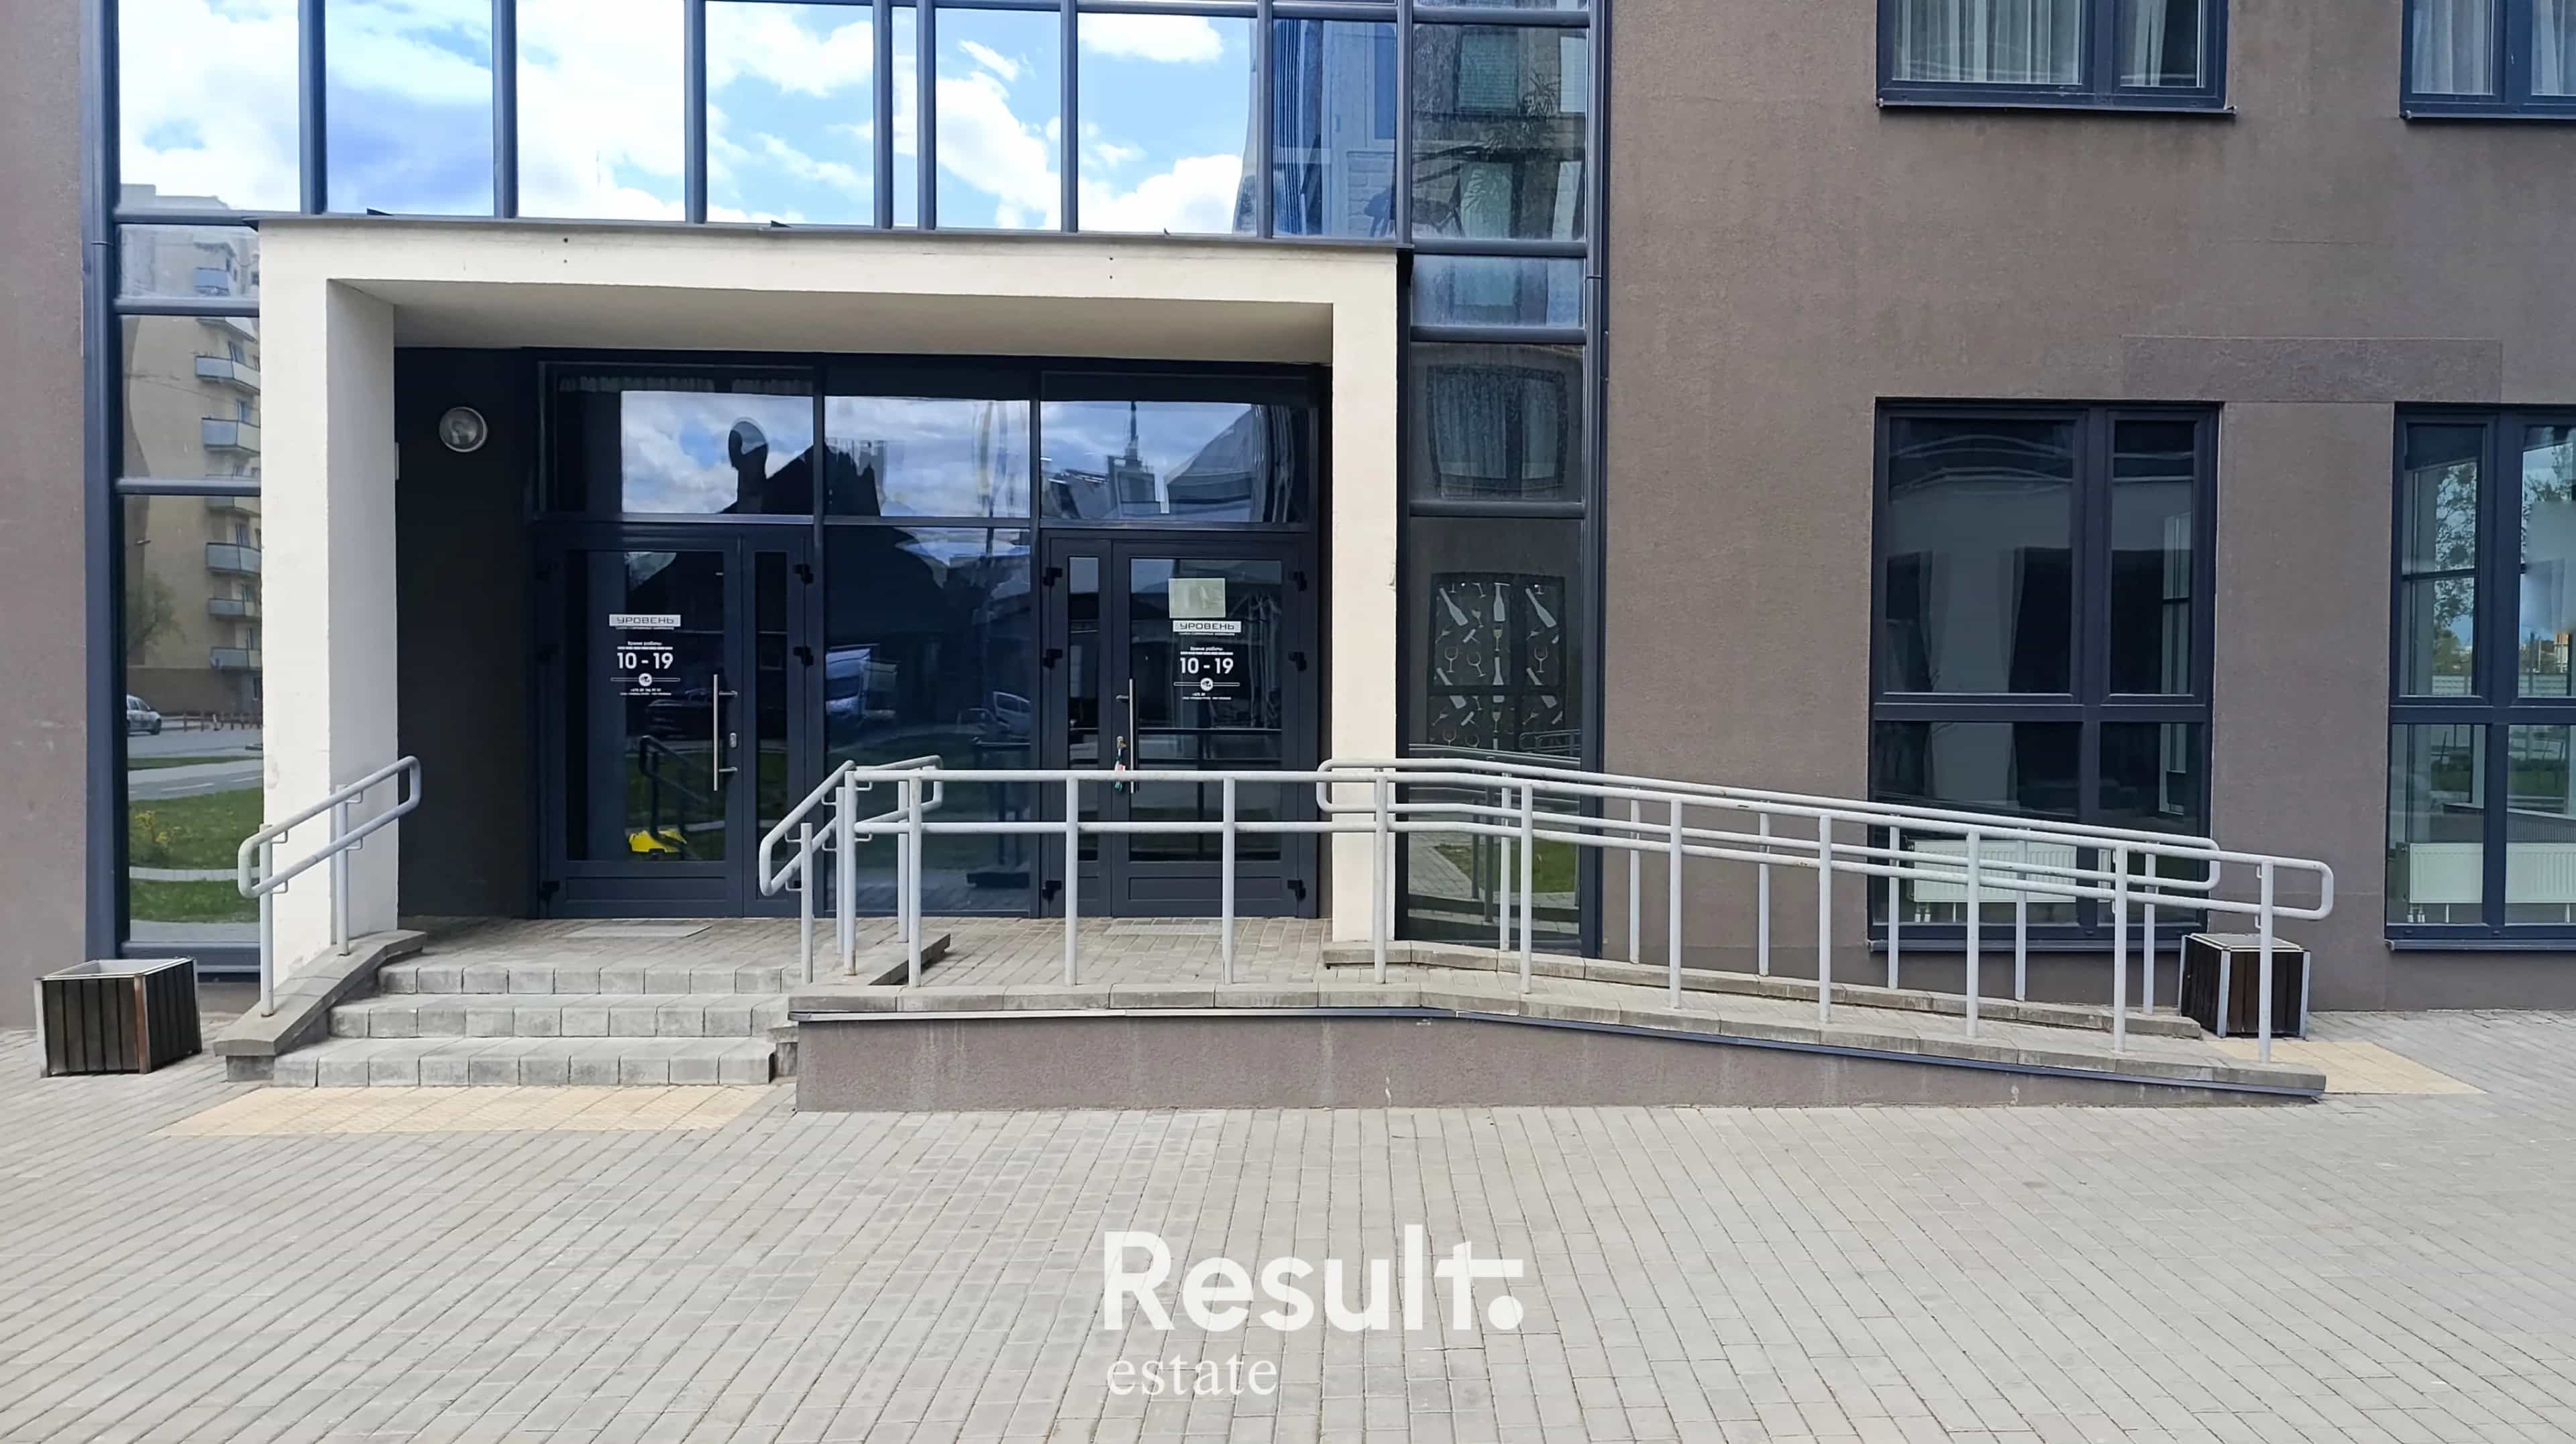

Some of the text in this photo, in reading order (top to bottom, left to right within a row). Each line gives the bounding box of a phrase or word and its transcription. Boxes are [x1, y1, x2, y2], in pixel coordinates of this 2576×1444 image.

[616, 616, 674, 624] УРОВЕНЬ
[1180, 622, 1235, 630] УРОВЕНЬ
[617, 652, 637, 669] 10
[653, 652, 674, 669] 19
[1180, 657, 1199, 674] 10
[1214, 657, 1234, 674] 19
